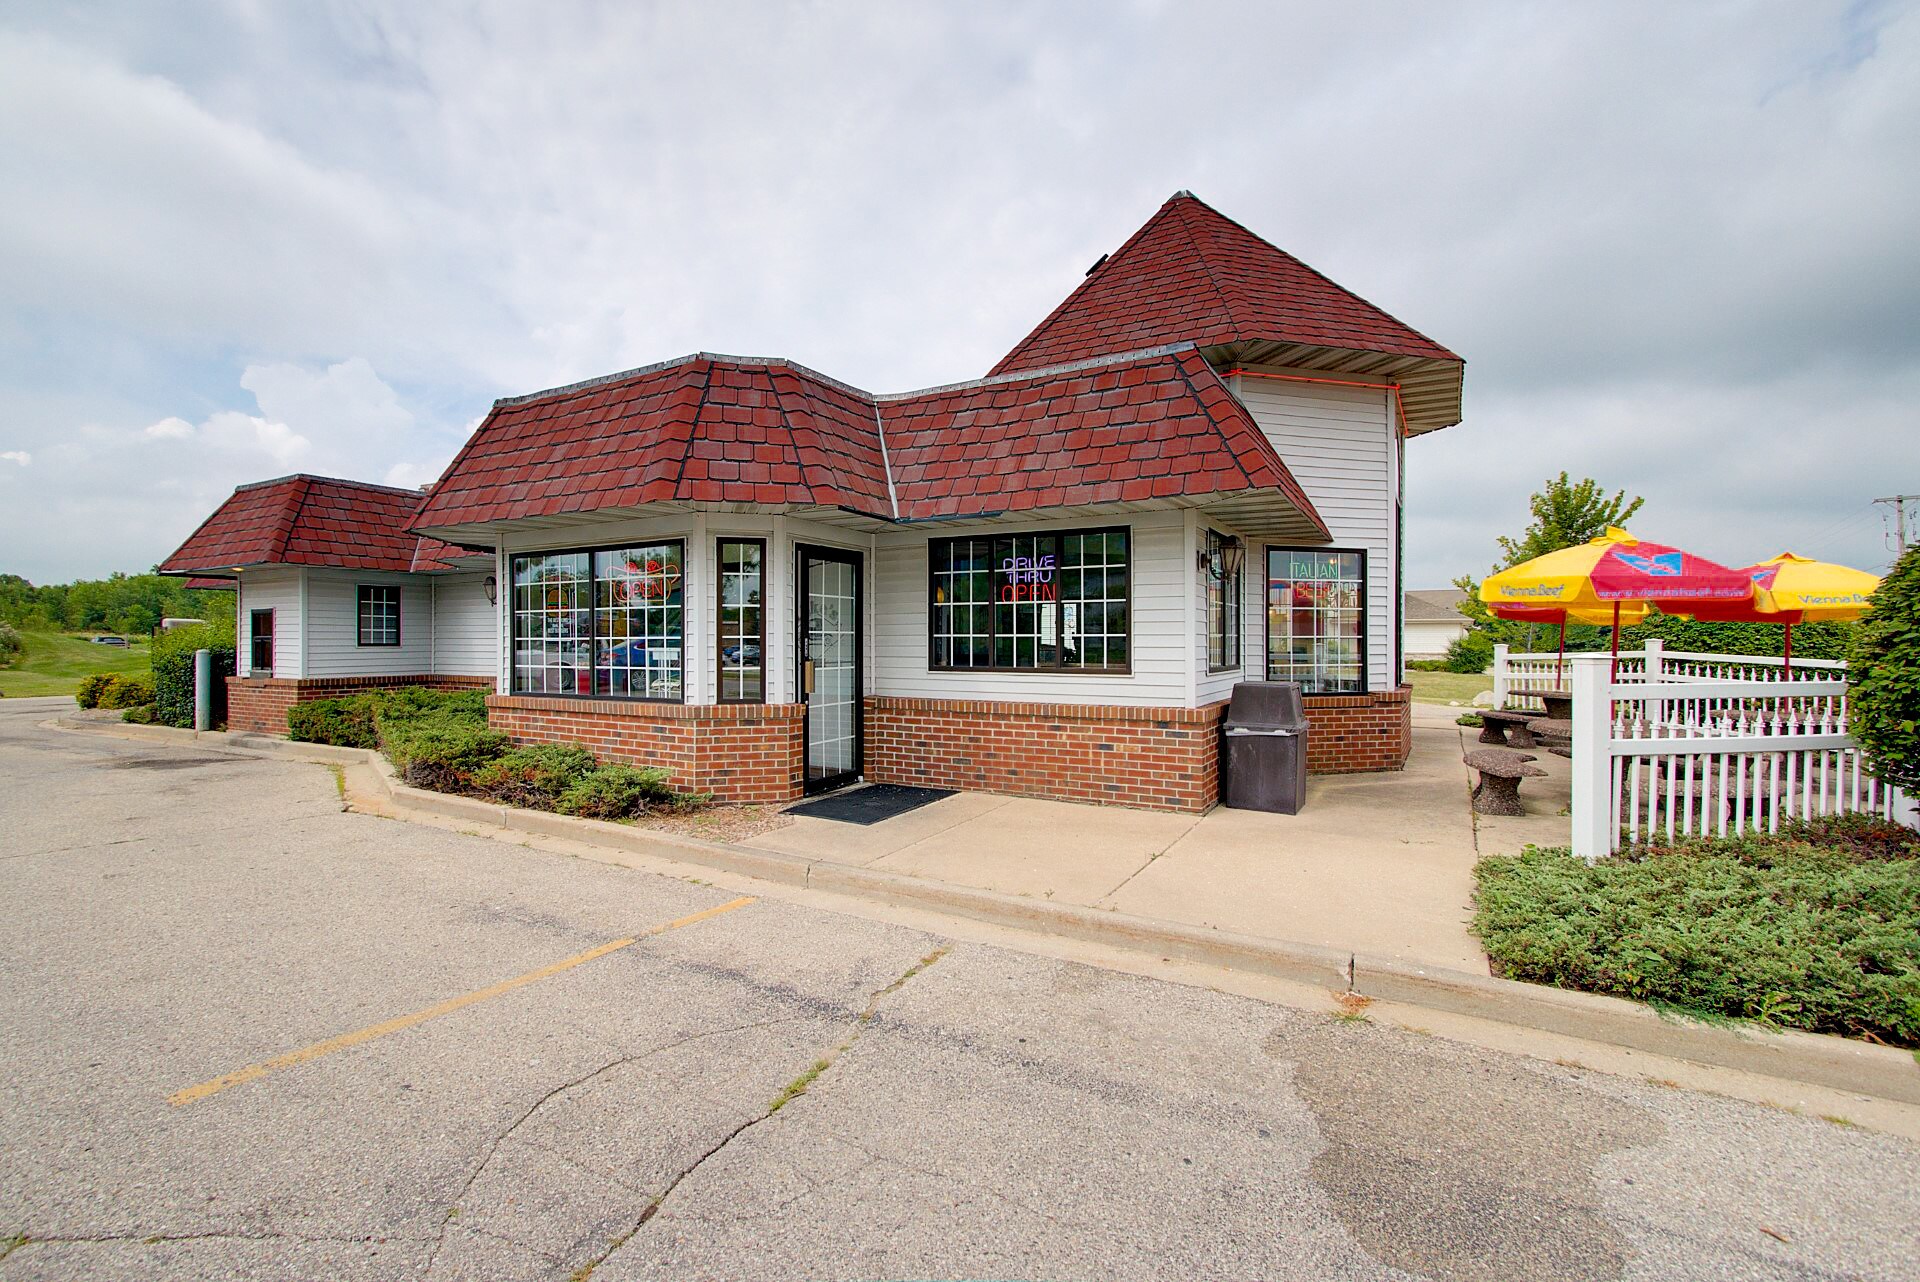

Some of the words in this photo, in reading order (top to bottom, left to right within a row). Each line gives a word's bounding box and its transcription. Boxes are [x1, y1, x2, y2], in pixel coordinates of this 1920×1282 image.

[1003, 555, 1054, 570] DRIVE
[1289, 562, 1338, 578] ITALIAN
[1006, 570, 1051, 583] THRU
[619, 578, 663, 599] OPEN
[1002, 583, 1056, 603] OPEN
[1798, 595, 1850, 604] Vienna
